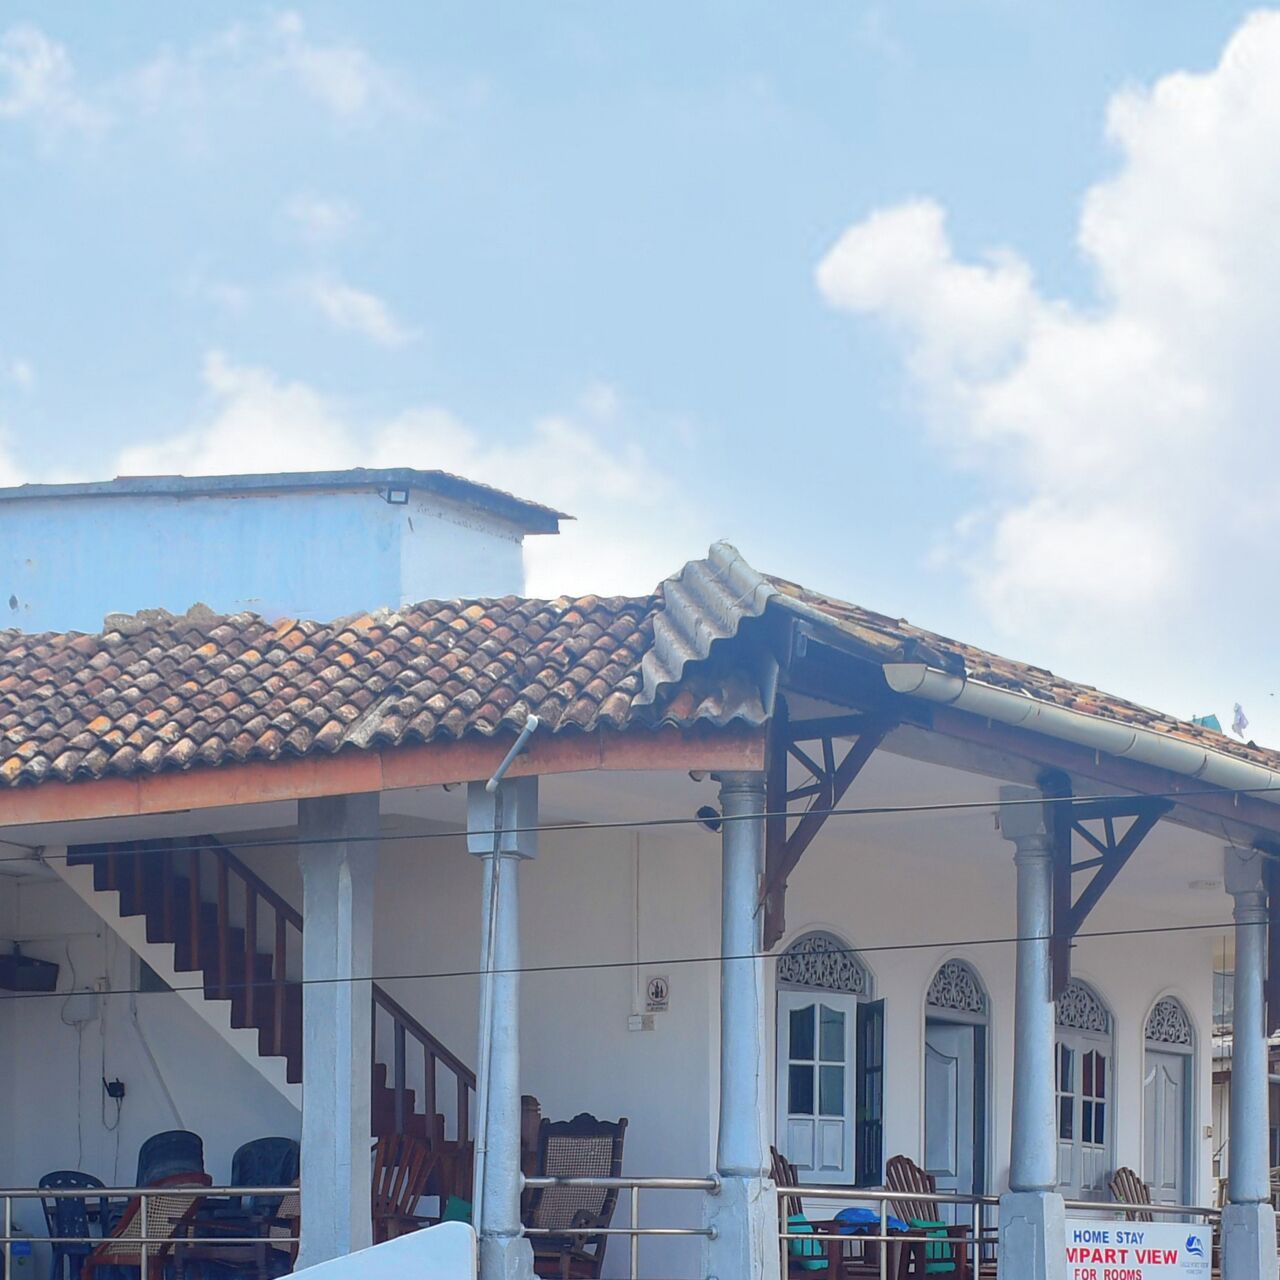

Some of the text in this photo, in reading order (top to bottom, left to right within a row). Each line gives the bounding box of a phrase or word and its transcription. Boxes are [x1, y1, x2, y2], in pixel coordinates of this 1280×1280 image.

[1073, 1230, 1145, 1245] HOME STAY
[1135, 1249, 1178, 1265] VIEW
